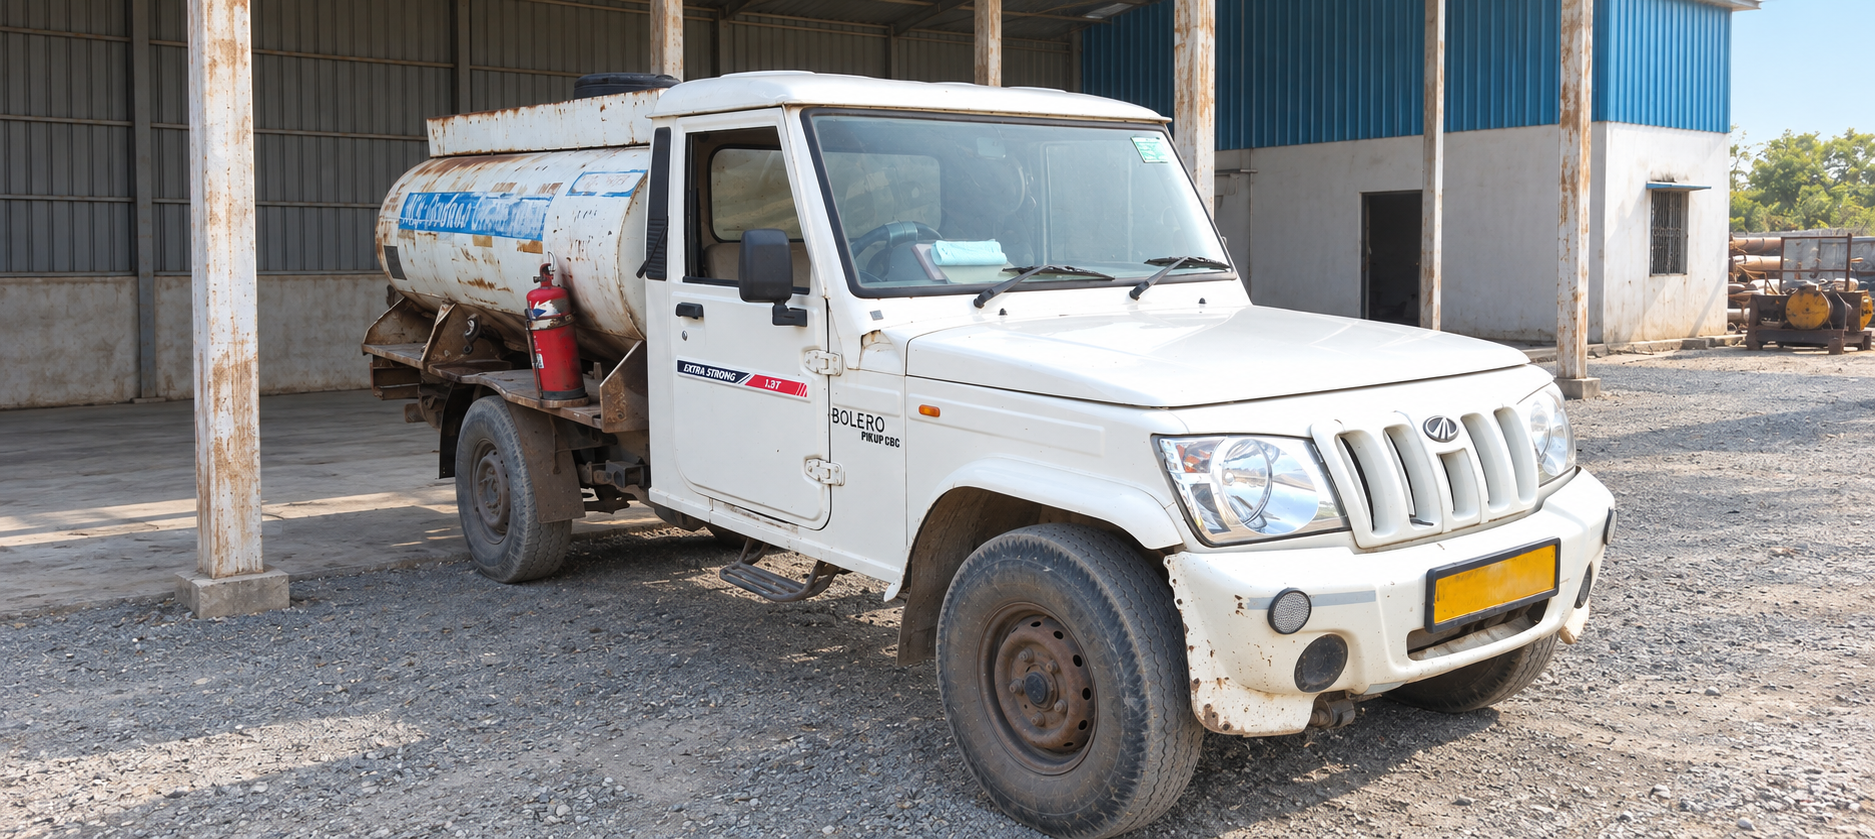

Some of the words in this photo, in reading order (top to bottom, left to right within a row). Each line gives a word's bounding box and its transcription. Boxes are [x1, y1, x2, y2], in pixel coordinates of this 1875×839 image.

[683, 363, 705, 376] EXTRA
[706, 368, 737, 381] STRONG
[764, 379, 782, 390] 1.3T
[831, 407, 885, 433] BOLERO
[884, 436, 900, 448] CBC
